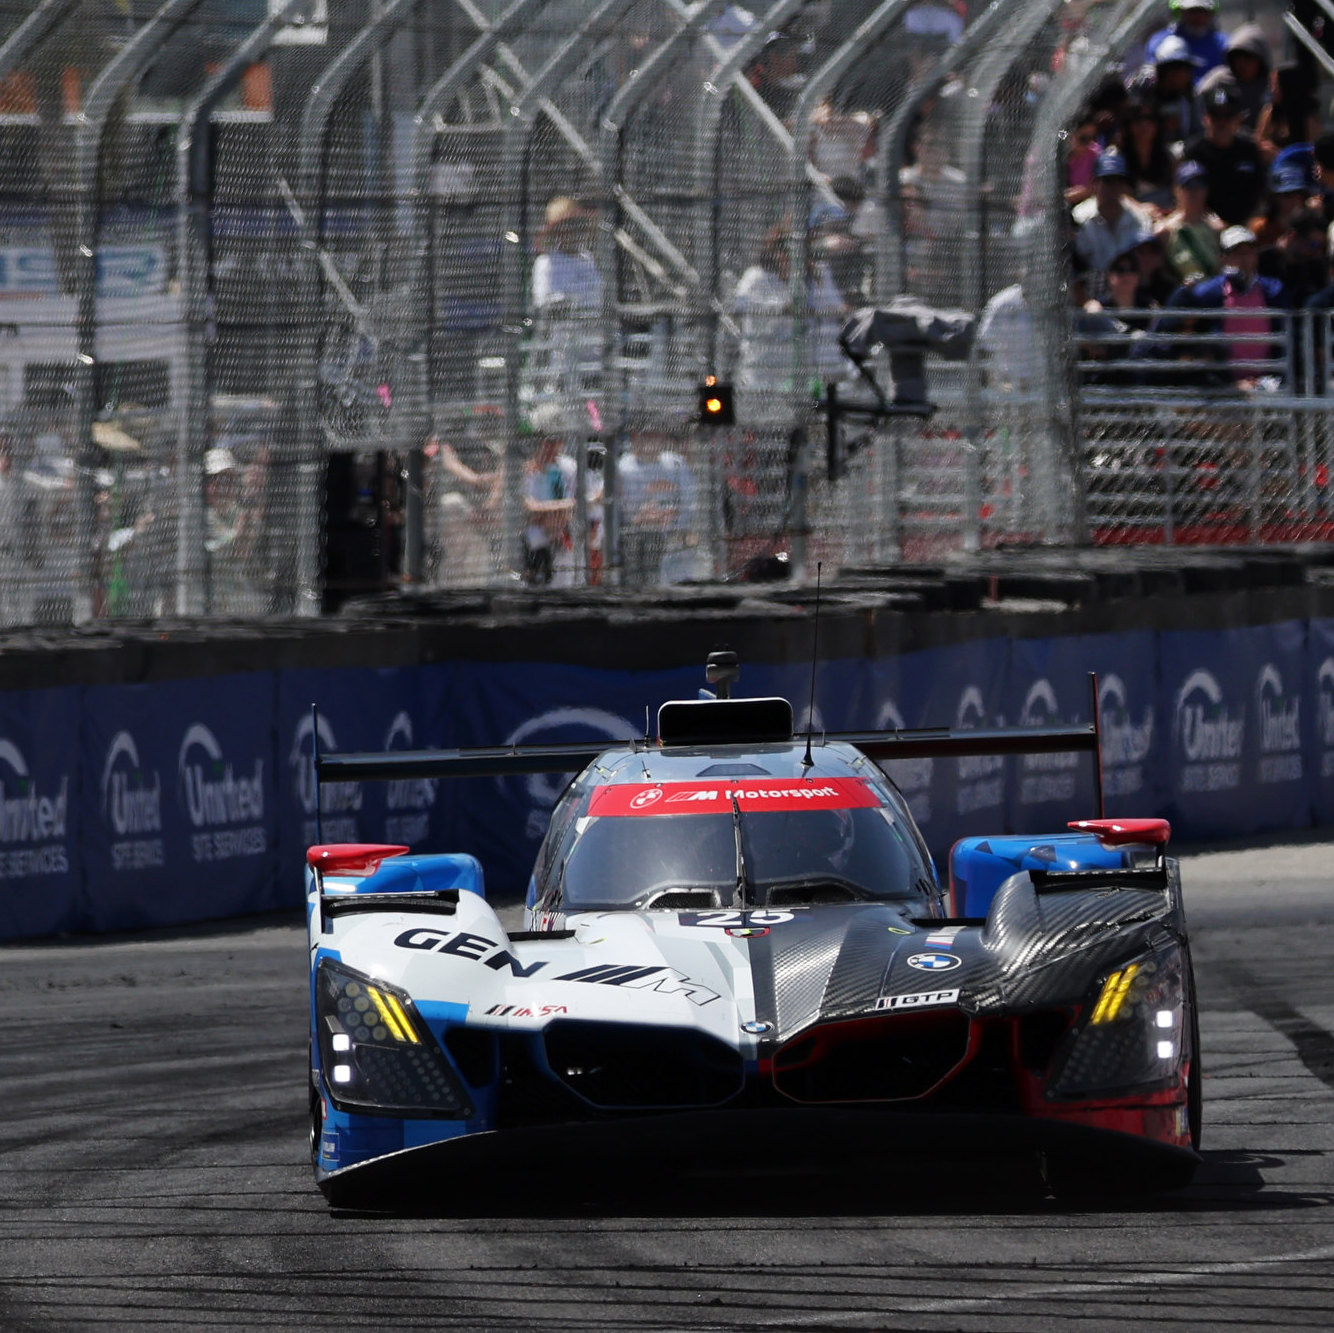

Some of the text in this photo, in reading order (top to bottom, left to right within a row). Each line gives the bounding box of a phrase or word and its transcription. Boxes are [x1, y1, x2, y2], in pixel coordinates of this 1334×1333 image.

[185, 758, 264, 827] United
[725, 786, 839, 800] Motorsport
[696, 910, 795, 926] 25
[394, 928, 550, 978] GEN
[902, 991, 954, 1005] GTP
